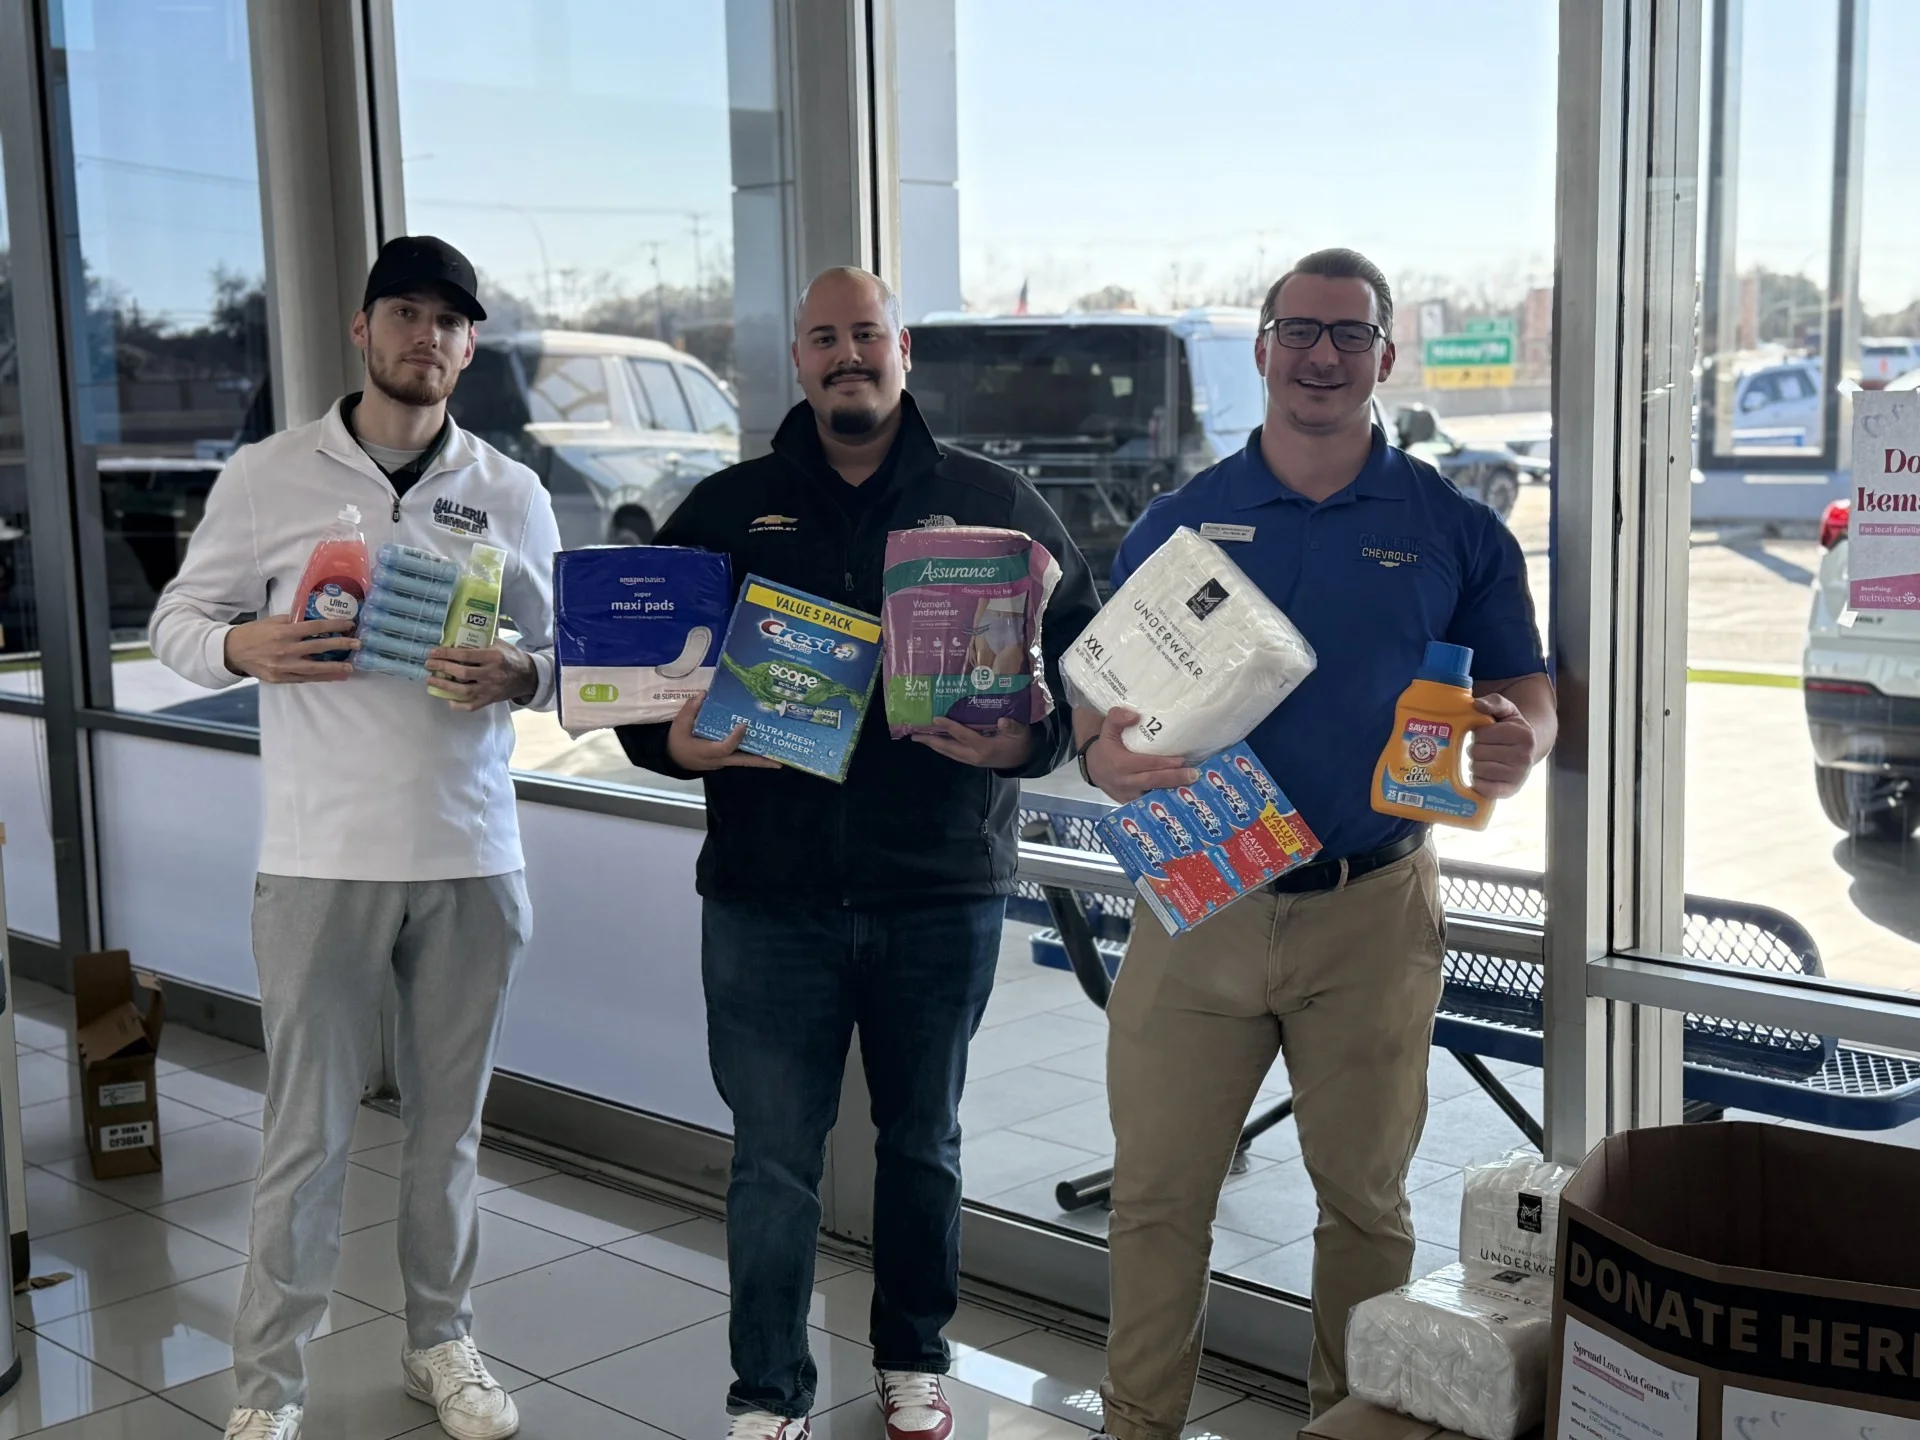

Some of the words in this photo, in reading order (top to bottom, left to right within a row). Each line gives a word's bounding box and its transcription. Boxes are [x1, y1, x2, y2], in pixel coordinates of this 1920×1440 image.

[1857, 487, 1920, 512] Item
[1362, 547, 1418, 562] CHEVROLET
[917, 560, 996, 581] Assurance
[329, 598, 349, 609] Ultra
[611, 599, 641, 610] maxi
[645, 599, 675, 613] pads
[775, 595, 812, 618] VALUE
[812, 609, 822, 621] 5
[822, 613, 853, 632] PACK
[912, 609, 958, 617] underwear
[913, 600, 951, 608] Women's
[760, 619, 836, 655] Crest
[773, 637, 812, 655] complete
[1083, 633, 1105, 661] XXL
[1133, 599, 1204, 680] UNDERWEAR
[1137, 622, 1148, 635] for
[1146, 632, 1157, 646] men
[1161, 650, 1179, 671] women
[768, 663, 819, 689] scope
[975, 668, 990, 680] 19
[585, 687, 596, 695] 48
[731, 714, 753, 727] FEEL
[755, 723, 784, 738] ULTRA
[786, 732, 816, 748] FRESH
[759, 733, 770, 742] 7X
[1138, 725, 1155, 743] COUNT
[1146, 716, 1163, 736] 12
[1408, 722, 1428, 733] SAVE
[1234, 756, 1279, 806] Crest
[1403, 773, 1432, 783] CLEAN
[1410, 766, 1427, 775] OXI
[1206, 770, 1251, 821] Crest
[1387, 789, 1396, 798] 25
[1178, 787, 1222, 838] Crest
[1149, 802, 1193, 854] Crest
[1262, 815, 1290, 849] 5-PACK
[1270, 811, 1298, 846] VALUE
[1289, 822, 1311, 848] CAVITY
[1121, 818, 1163, 870] Crest
[1244, 830, 1272, 864] CAVITY
[1480, 1248, 1556, 1277] UNDERWE
[1570, 1241, 1758, 1353] DONATE
[1573, 1341, 1602, 1364] Spread
[1603, 1355, 1622, 1377] Love,
[1623, 1368, 1639, 1385] Not
[1640, 1377, 1670, 1400] Germs
